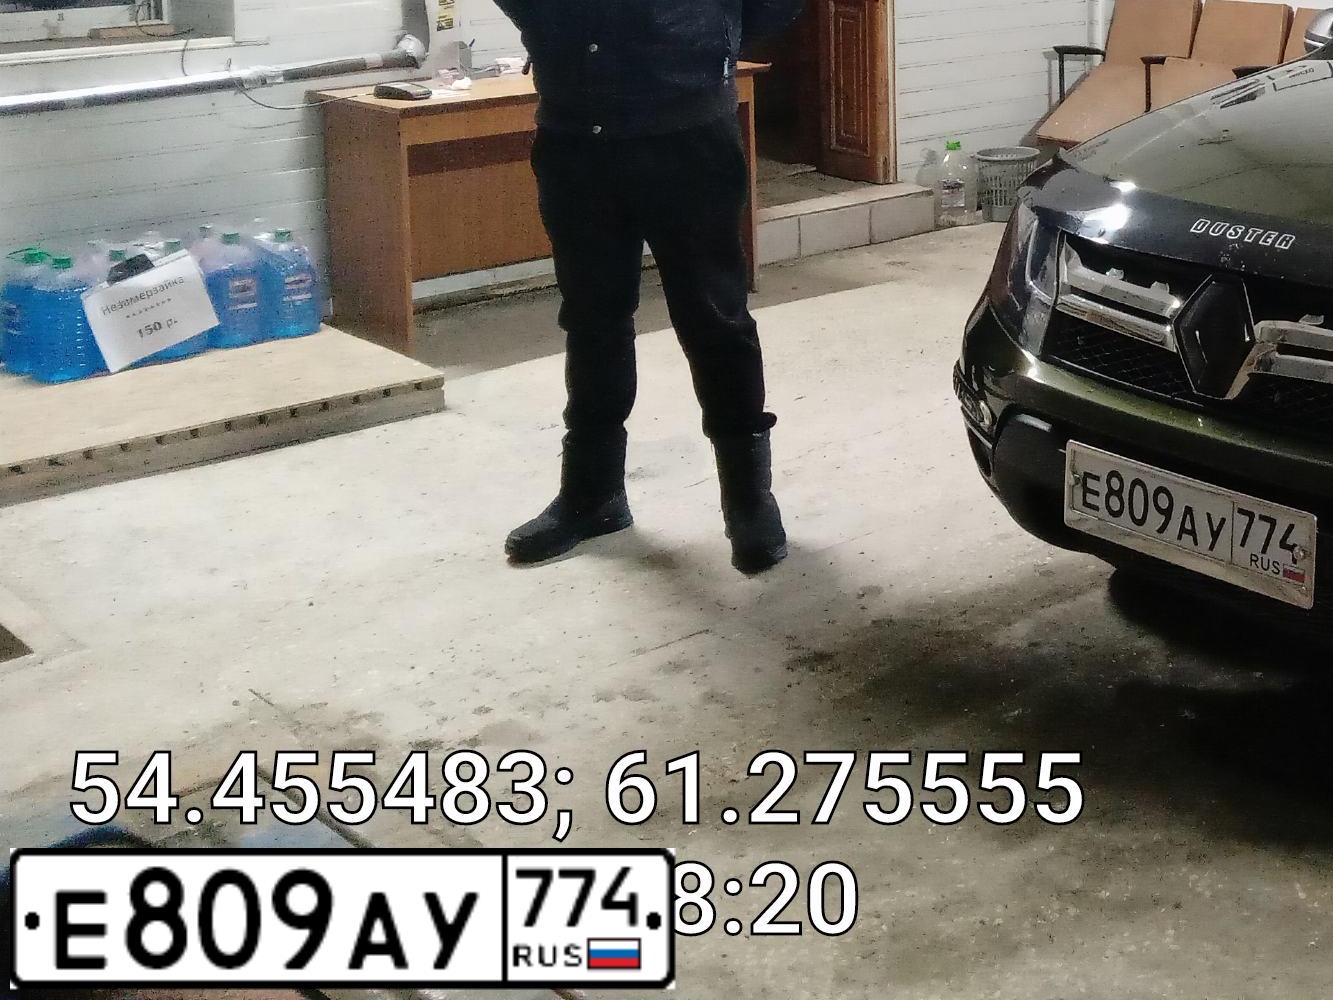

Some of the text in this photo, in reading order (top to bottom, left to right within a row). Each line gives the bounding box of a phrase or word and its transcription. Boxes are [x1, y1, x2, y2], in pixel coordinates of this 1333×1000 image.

[1189, 218, 1296, 250] DUSTER
[136, 321, 163, 338] 150
[1237, 507, 1299, 565] 774
[1249, 553, 1282, 575] RUS
